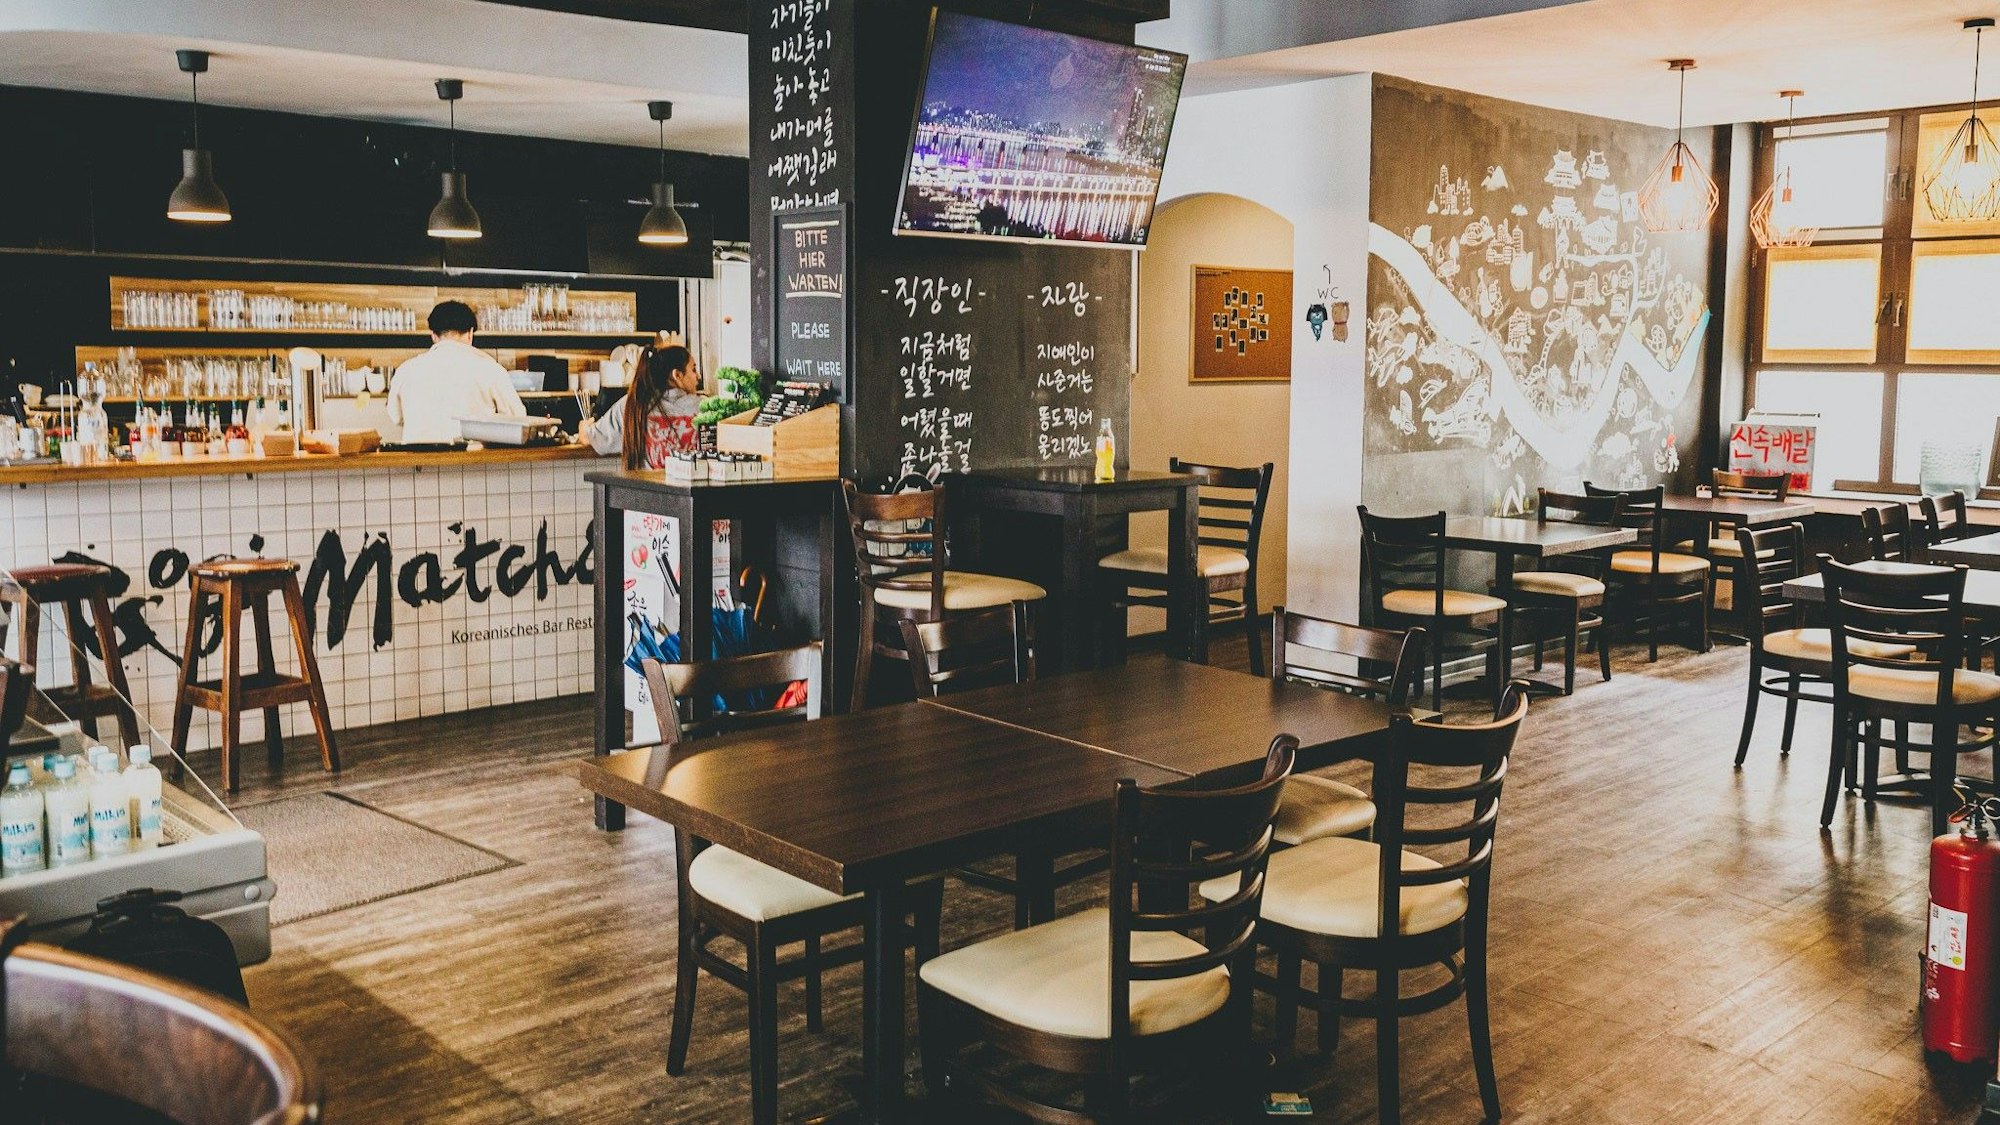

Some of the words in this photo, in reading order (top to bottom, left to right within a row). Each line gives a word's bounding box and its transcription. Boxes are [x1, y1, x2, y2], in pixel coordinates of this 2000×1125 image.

[794, 229, 828, 248] BITTE
[799, 251, 826, 269] HIER
[1317, 286, 1339, 299] WC
[791, 321, 830, 340] PLEASE
[900, 331, 972, 362] 지금처럼
[785, 359, 813, 376] WAIT
[816, 361, 842, 377] HERE
[1731, 425, 1815, 463] 신속배달
[451, 624, 539, 644] Koreanisches
[543, 620, 563, 634] Bar
